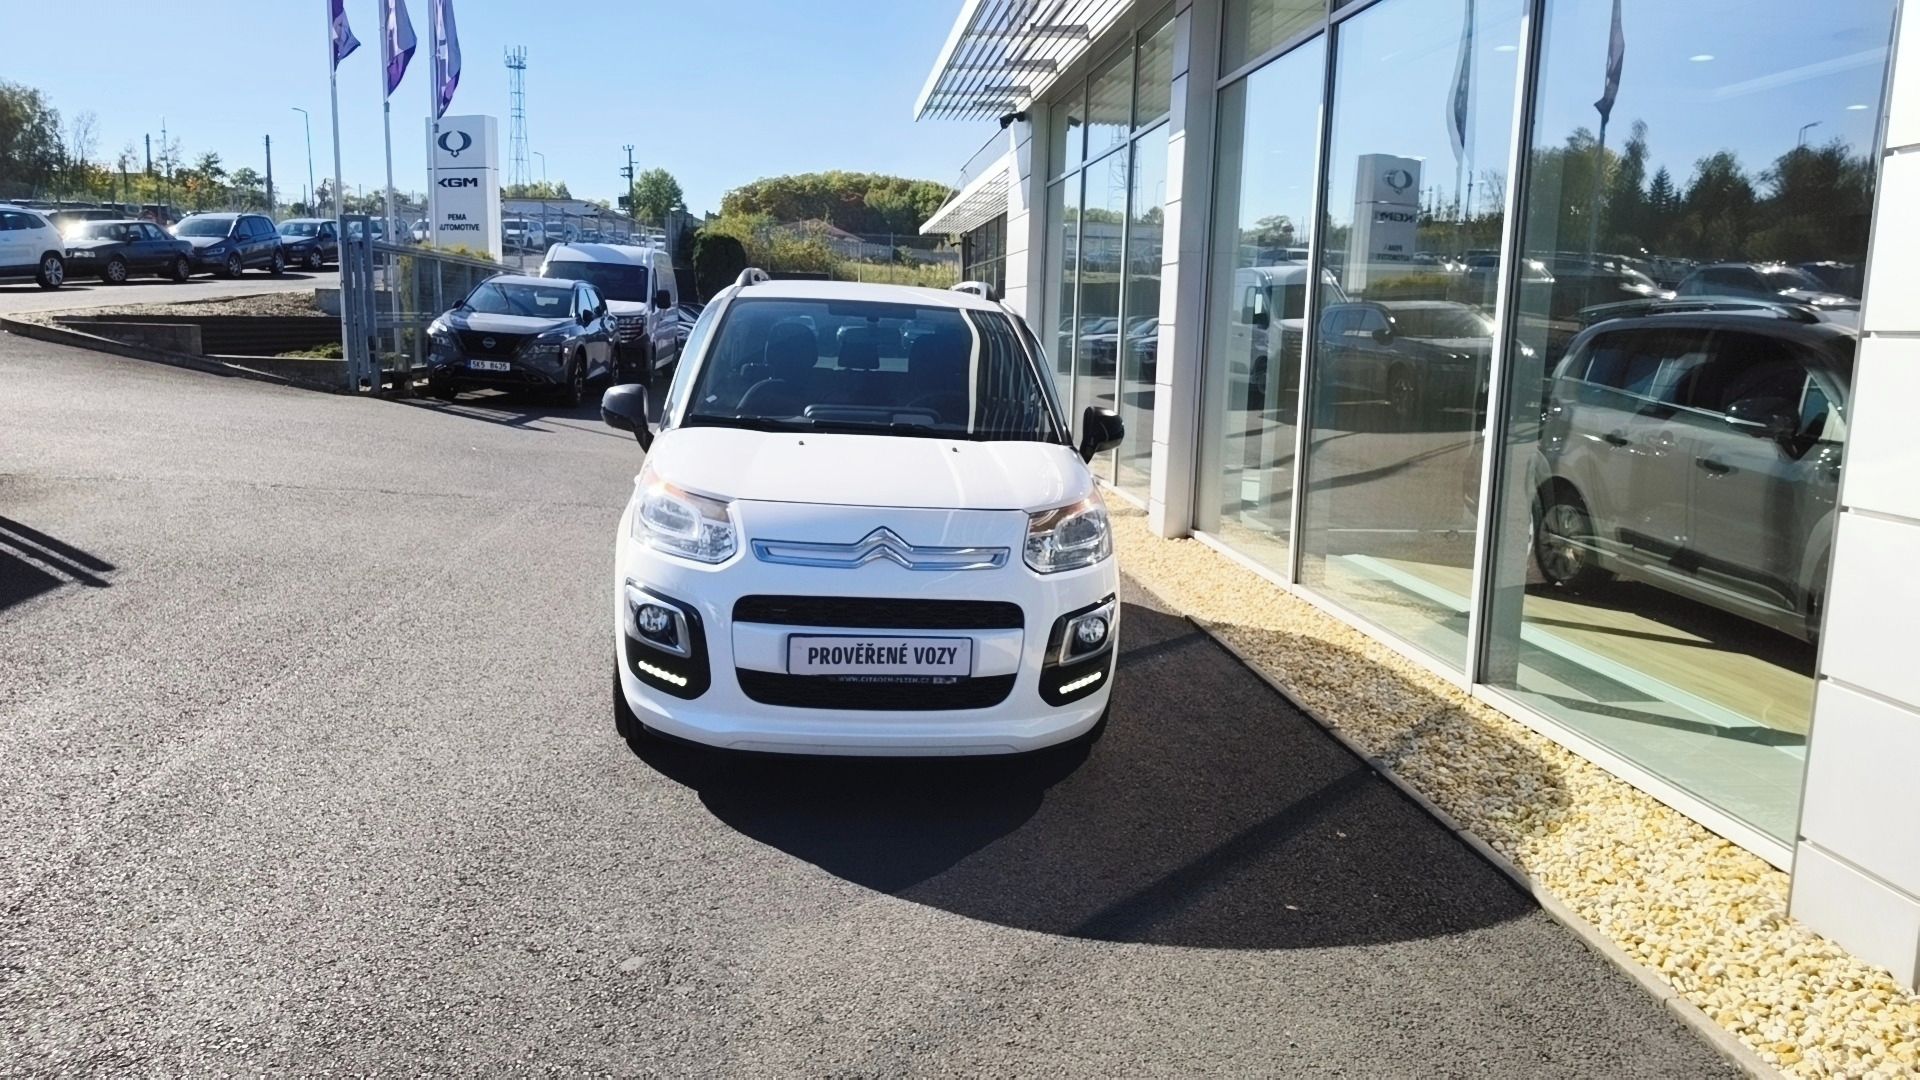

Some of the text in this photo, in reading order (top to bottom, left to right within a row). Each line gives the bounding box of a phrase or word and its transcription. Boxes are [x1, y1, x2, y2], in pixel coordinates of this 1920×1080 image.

[438, 178, 478, 188] KGM
[447, 213, 467, 221] PEMA
[807, 643, 958, 665] PROVĚŘENÉ VOZY
